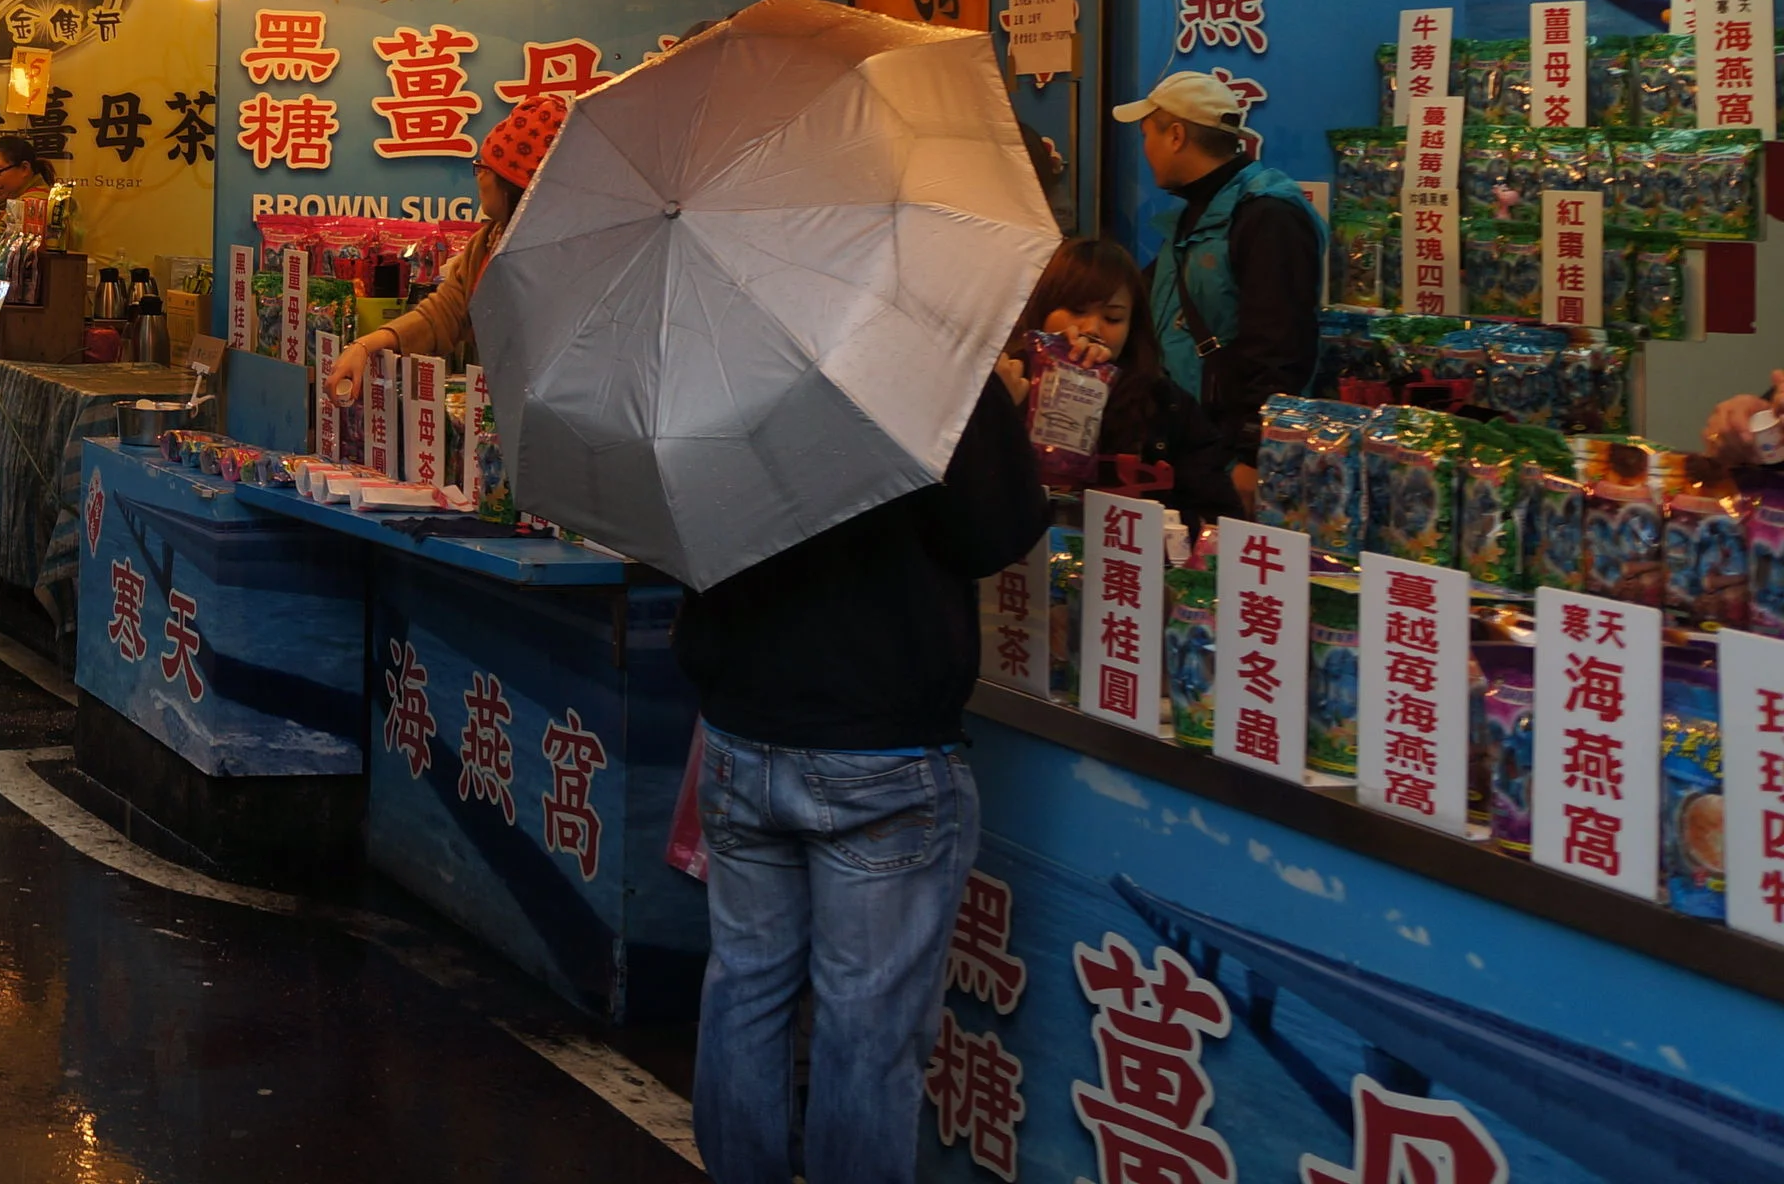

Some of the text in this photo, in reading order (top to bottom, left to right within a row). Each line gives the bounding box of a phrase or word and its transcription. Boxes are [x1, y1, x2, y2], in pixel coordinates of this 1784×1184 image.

[242, 9, 341, 171] 黑糖
[1543, 8, 1573, 128] 薑母茶
[1714, 20, 1756, 126] 海燕窩
[94, 175, 144, 190] Sugar
[252, 193, 390, 222] BROWN
[232, 252, 247, 350] 黑糖桂花
[285, 254, 302, 364] 薑母茶
[1414, 209, 1446, 316] 玫瑰四物
[1556, 199, 1586, 325] 紅棗桂圓
[320, 336, 335, 460] 蔓越海燕窩
[369, 351, 388, 476] 紅棗桂圓
[417, 361, 436, 486] 薑母茶
[107, 555, 205, 704] 寒天
[995, 558, 1031, 680] 母茶
[1099, 503, 1144, 722] 紅棗桂圓
[1235, 533, 1285, 767] 牛蒡冬蟲
[1561, 603, 1627, 650] 寒天
[1384, 569, 1439, 817] 蔓越莓海燕窩
[383, 636, 608, 883] 海燕窩
[1562, 652, 1625, 878] 海燕窩
